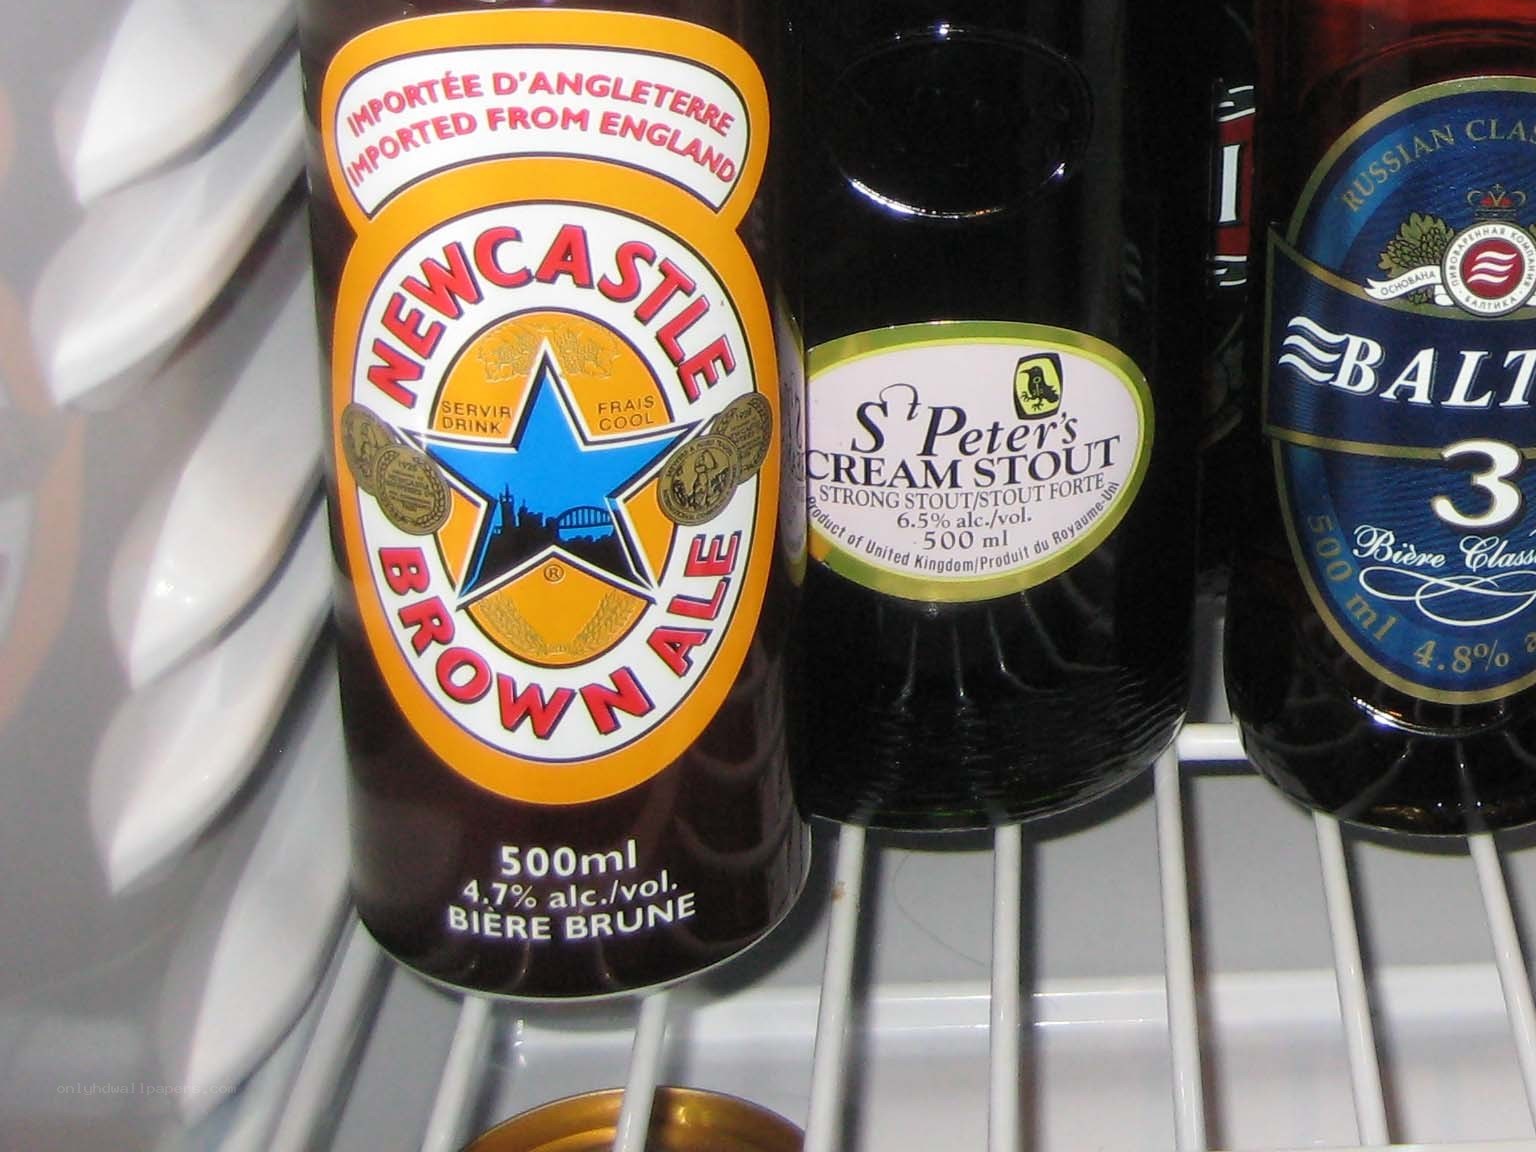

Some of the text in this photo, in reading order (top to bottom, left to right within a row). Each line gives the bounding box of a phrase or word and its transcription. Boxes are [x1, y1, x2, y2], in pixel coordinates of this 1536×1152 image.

[346, 70, 737, 138] IMPORTÉE D'ANGLETERRE
[346, 105, 738, 188] IMPORTED FROM ENGLAND
[1341, 122, 1456, 213] RUSSIAN
[1379, 269, 1437, 297] ОСНОВАНА
[1464, 295, 1518, 312] БАЛТИКА
[366, 223, 738, 410] NEWCASTLE
[442, 399, 513, 420] SERVIR
[442, 416, 503, 435] DRINK
[597, 394, 655, 415] FRAIS
[599, 411, 655, 431] COOL
[916, 405, 1079, 458] Peter's
[805, 434, 1122, 490] CREAM STOUT
[1430, 439, 1523, 528] 3
[818, 472, 1105, 511] STRONG STOUT/STOUT FORTE
[846, 534, 866, 548] of
[864, 538, 910, 567] United
[913, 547, 1030, 575] Kingdom/Produit
[1033, 539, 1050, 556] du
[1052, 480, 1121, 545] Royaume-Uni
[896, 508, 1033, 530] 6.5% alc./vol.
[922, 529, 1009, 551] 500 ml
[1352, 524, 1447, 571] Bière
[646, 529, 743, 677] ALE
[1305, 513, 1355, 585] 500
[1345, 591, 1399, 641] ml
[1413, 638, 1511, 675] 4.8%
[378, 546, 656, 740] BROWN
[500, 839, 638, 879] 500ml
[463, 869, 680, 909] 4.7% alc./vol.
[446, 893, 697, 941] BIÈRE BRUNE
